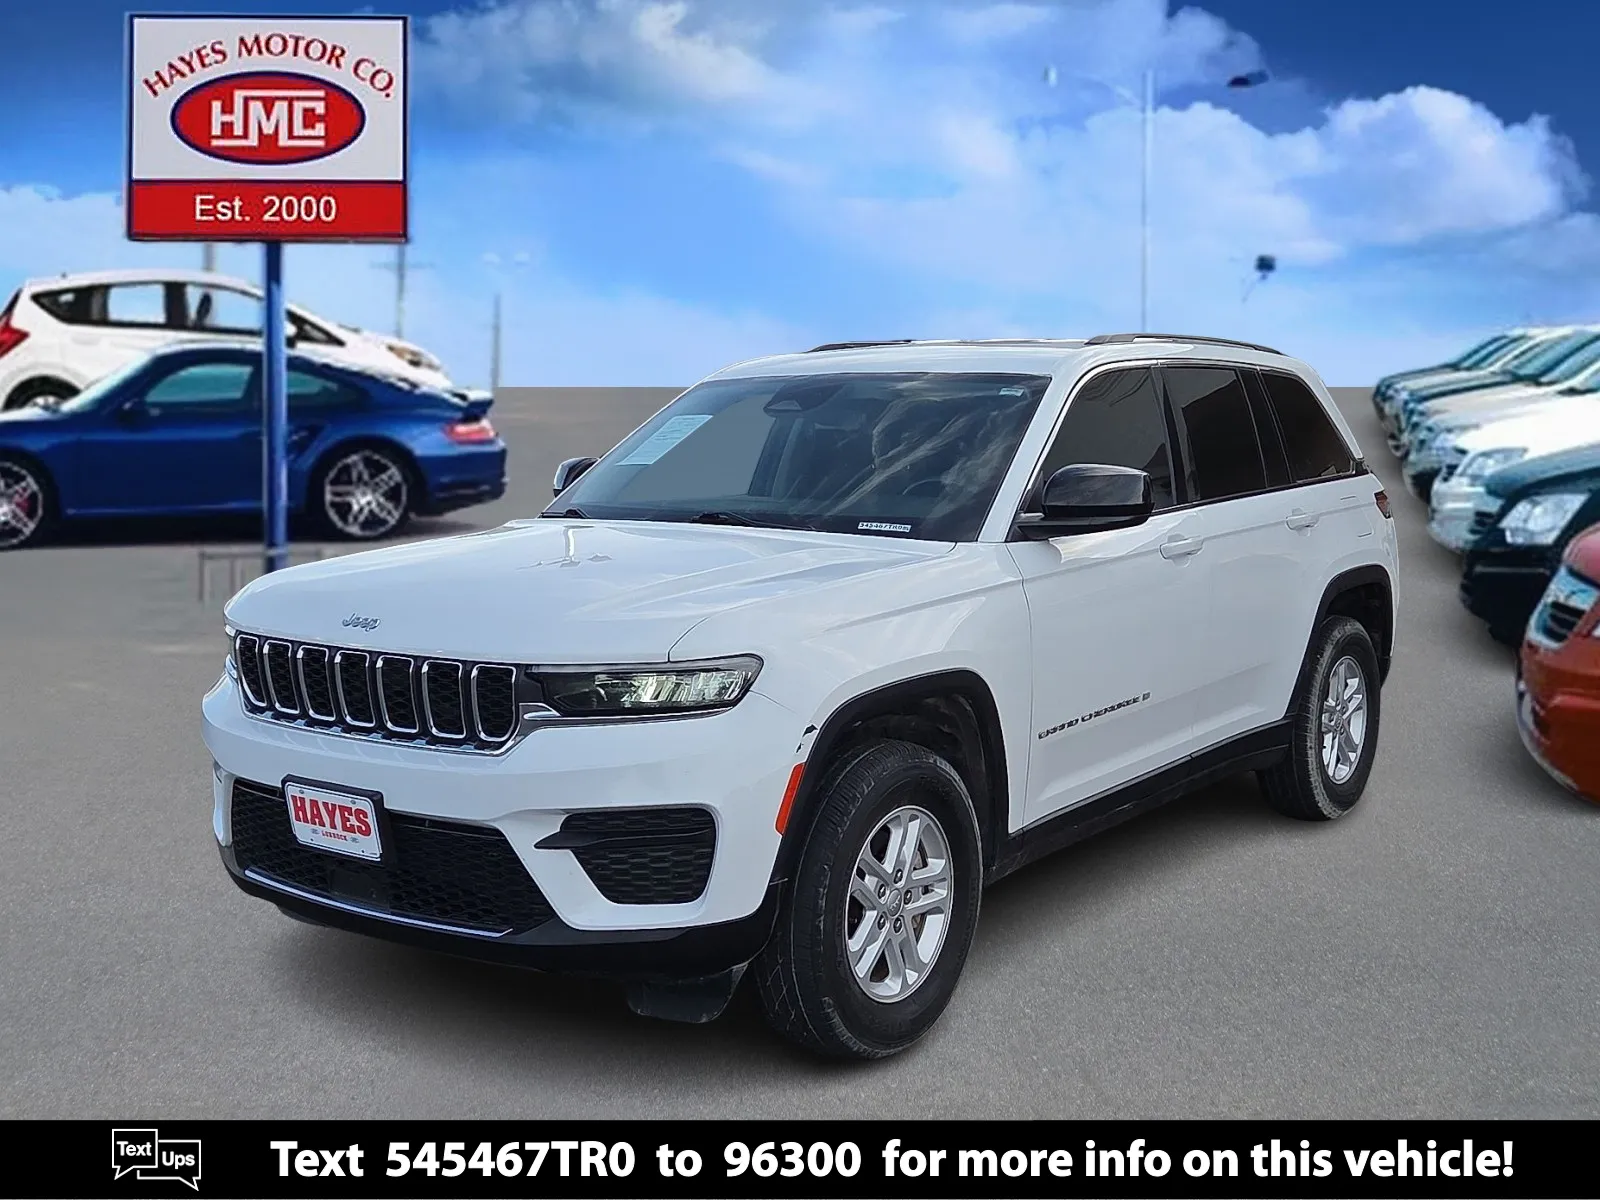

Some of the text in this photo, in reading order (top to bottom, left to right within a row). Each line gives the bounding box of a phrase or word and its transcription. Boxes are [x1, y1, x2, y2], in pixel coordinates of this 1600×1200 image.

[142, 32, 394, 98] HAYES MOTOR CO.
[209, 89, 326, 147] HMC
[194, 194, 337, 222] Est. 2000
[342, 612, 381, 632] Jeep
[290, 794, 372, 837] HAYES
